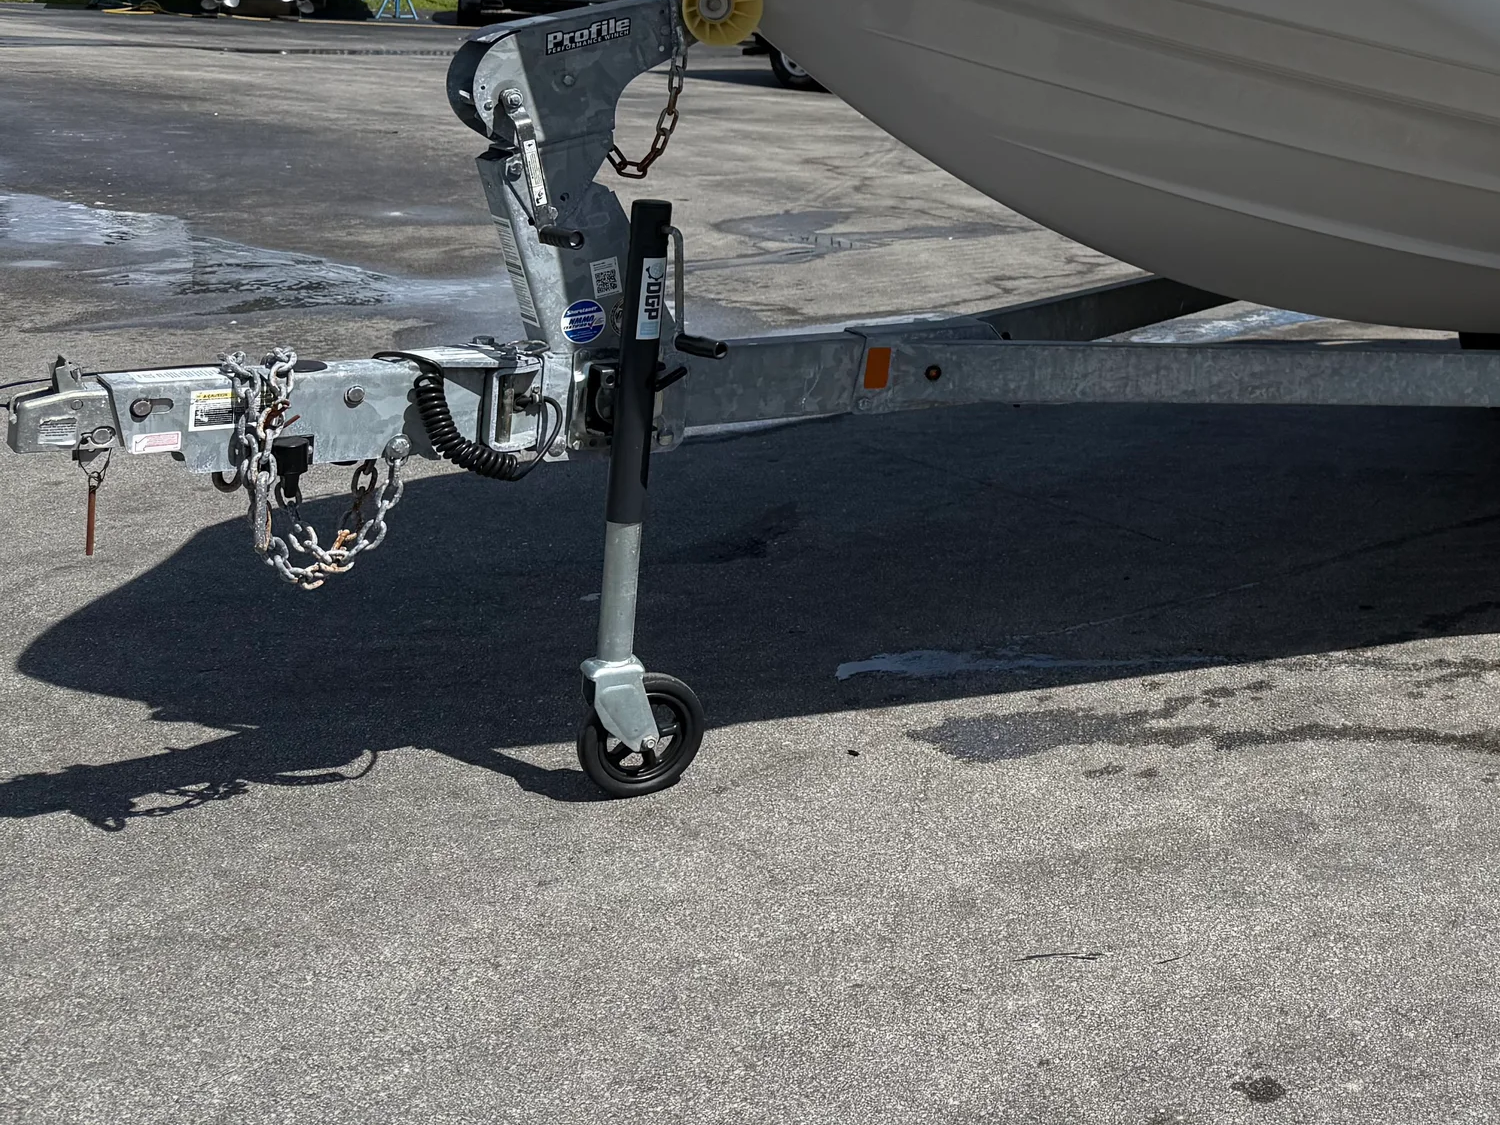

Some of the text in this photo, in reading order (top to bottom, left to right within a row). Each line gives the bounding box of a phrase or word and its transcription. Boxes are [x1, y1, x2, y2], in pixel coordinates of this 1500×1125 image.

[547, 18, 630, 49] Profile
[548, 30, 629, 54] PERFORMANCE WINCH
[644, 282, 661, 320] DGP
